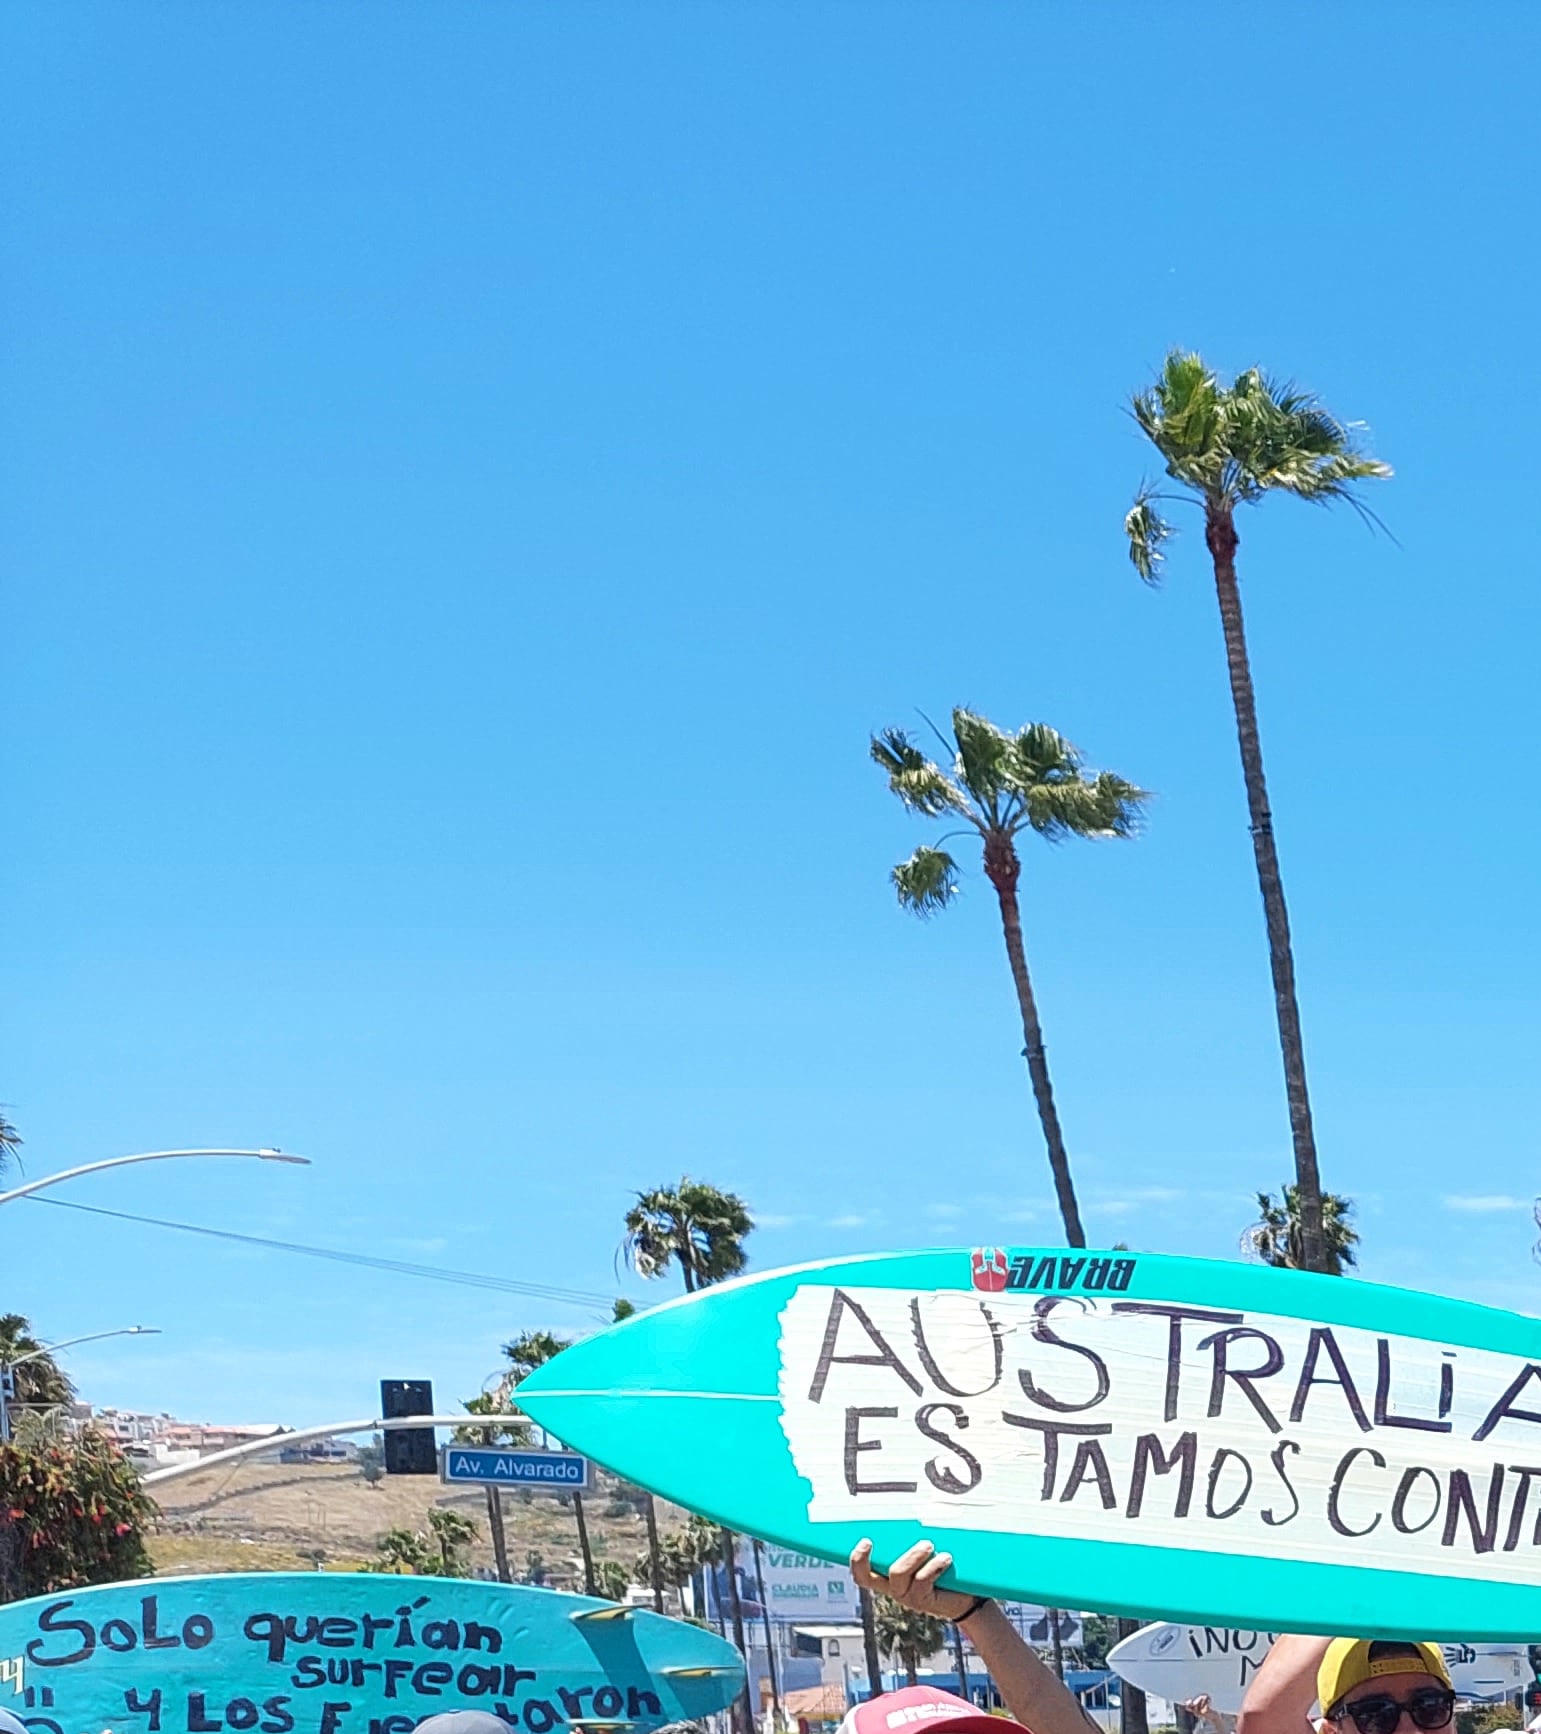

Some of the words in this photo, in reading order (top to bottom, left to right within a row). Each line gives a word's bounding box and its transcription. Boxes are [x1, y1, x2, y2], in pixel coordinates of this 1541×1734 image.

[1008, 1256, 1136, 1292] BRAVE
[455, 1456, 484, 1475] Av.
[494, 1457, 579, 1480] Alvarado
